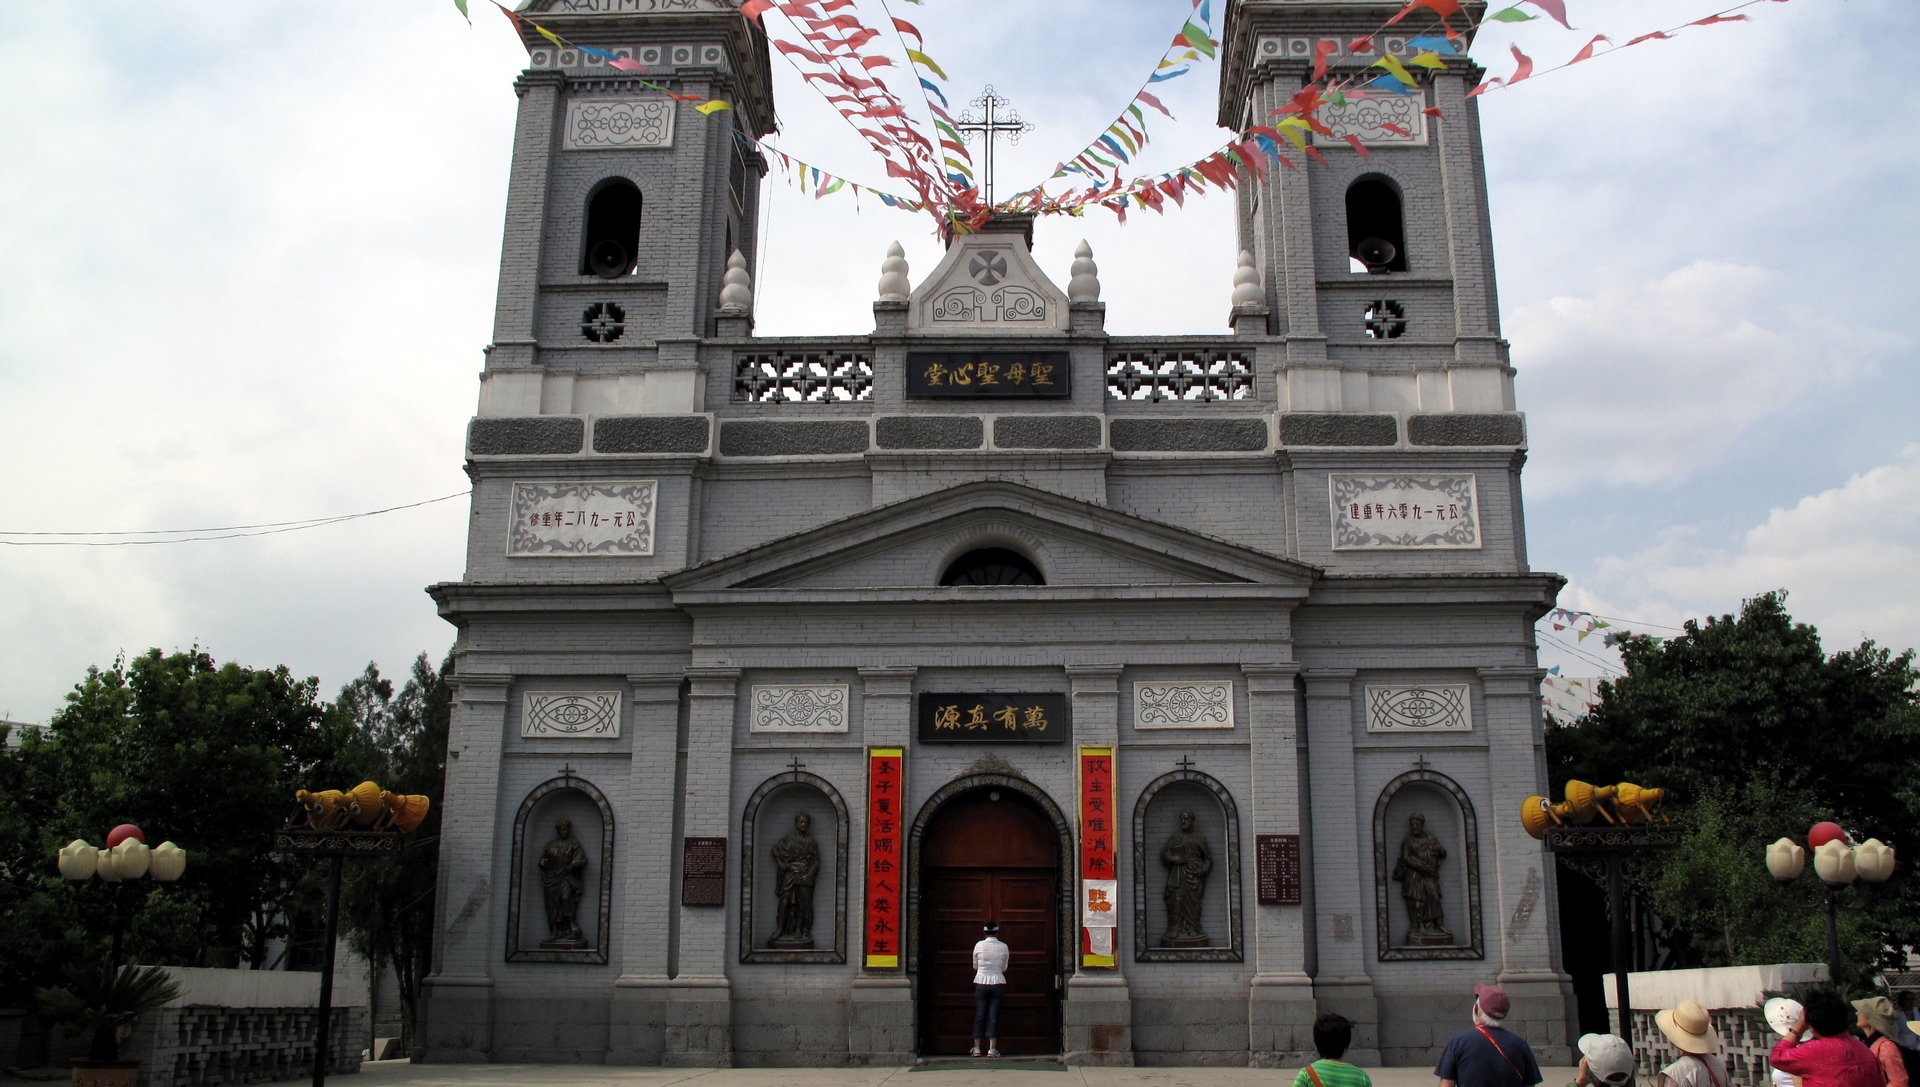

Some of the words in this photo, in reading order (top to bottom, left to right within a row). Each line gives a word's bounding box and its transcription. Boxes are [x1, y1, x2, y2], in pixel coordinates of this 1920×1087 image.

[924, 362, 1053, 386] 聖母聖心堂
[529, 511, 636, 527] 公元一九八二年重修
[1350, 502, 1458, 520] 公元一九零六年重建
[934, 703, 1048, 731] 萬有真源
[1087, 758, 1109, 880] 救主受难消除
[872, 761, 895, 954] 圣子复活赐给人类永生
